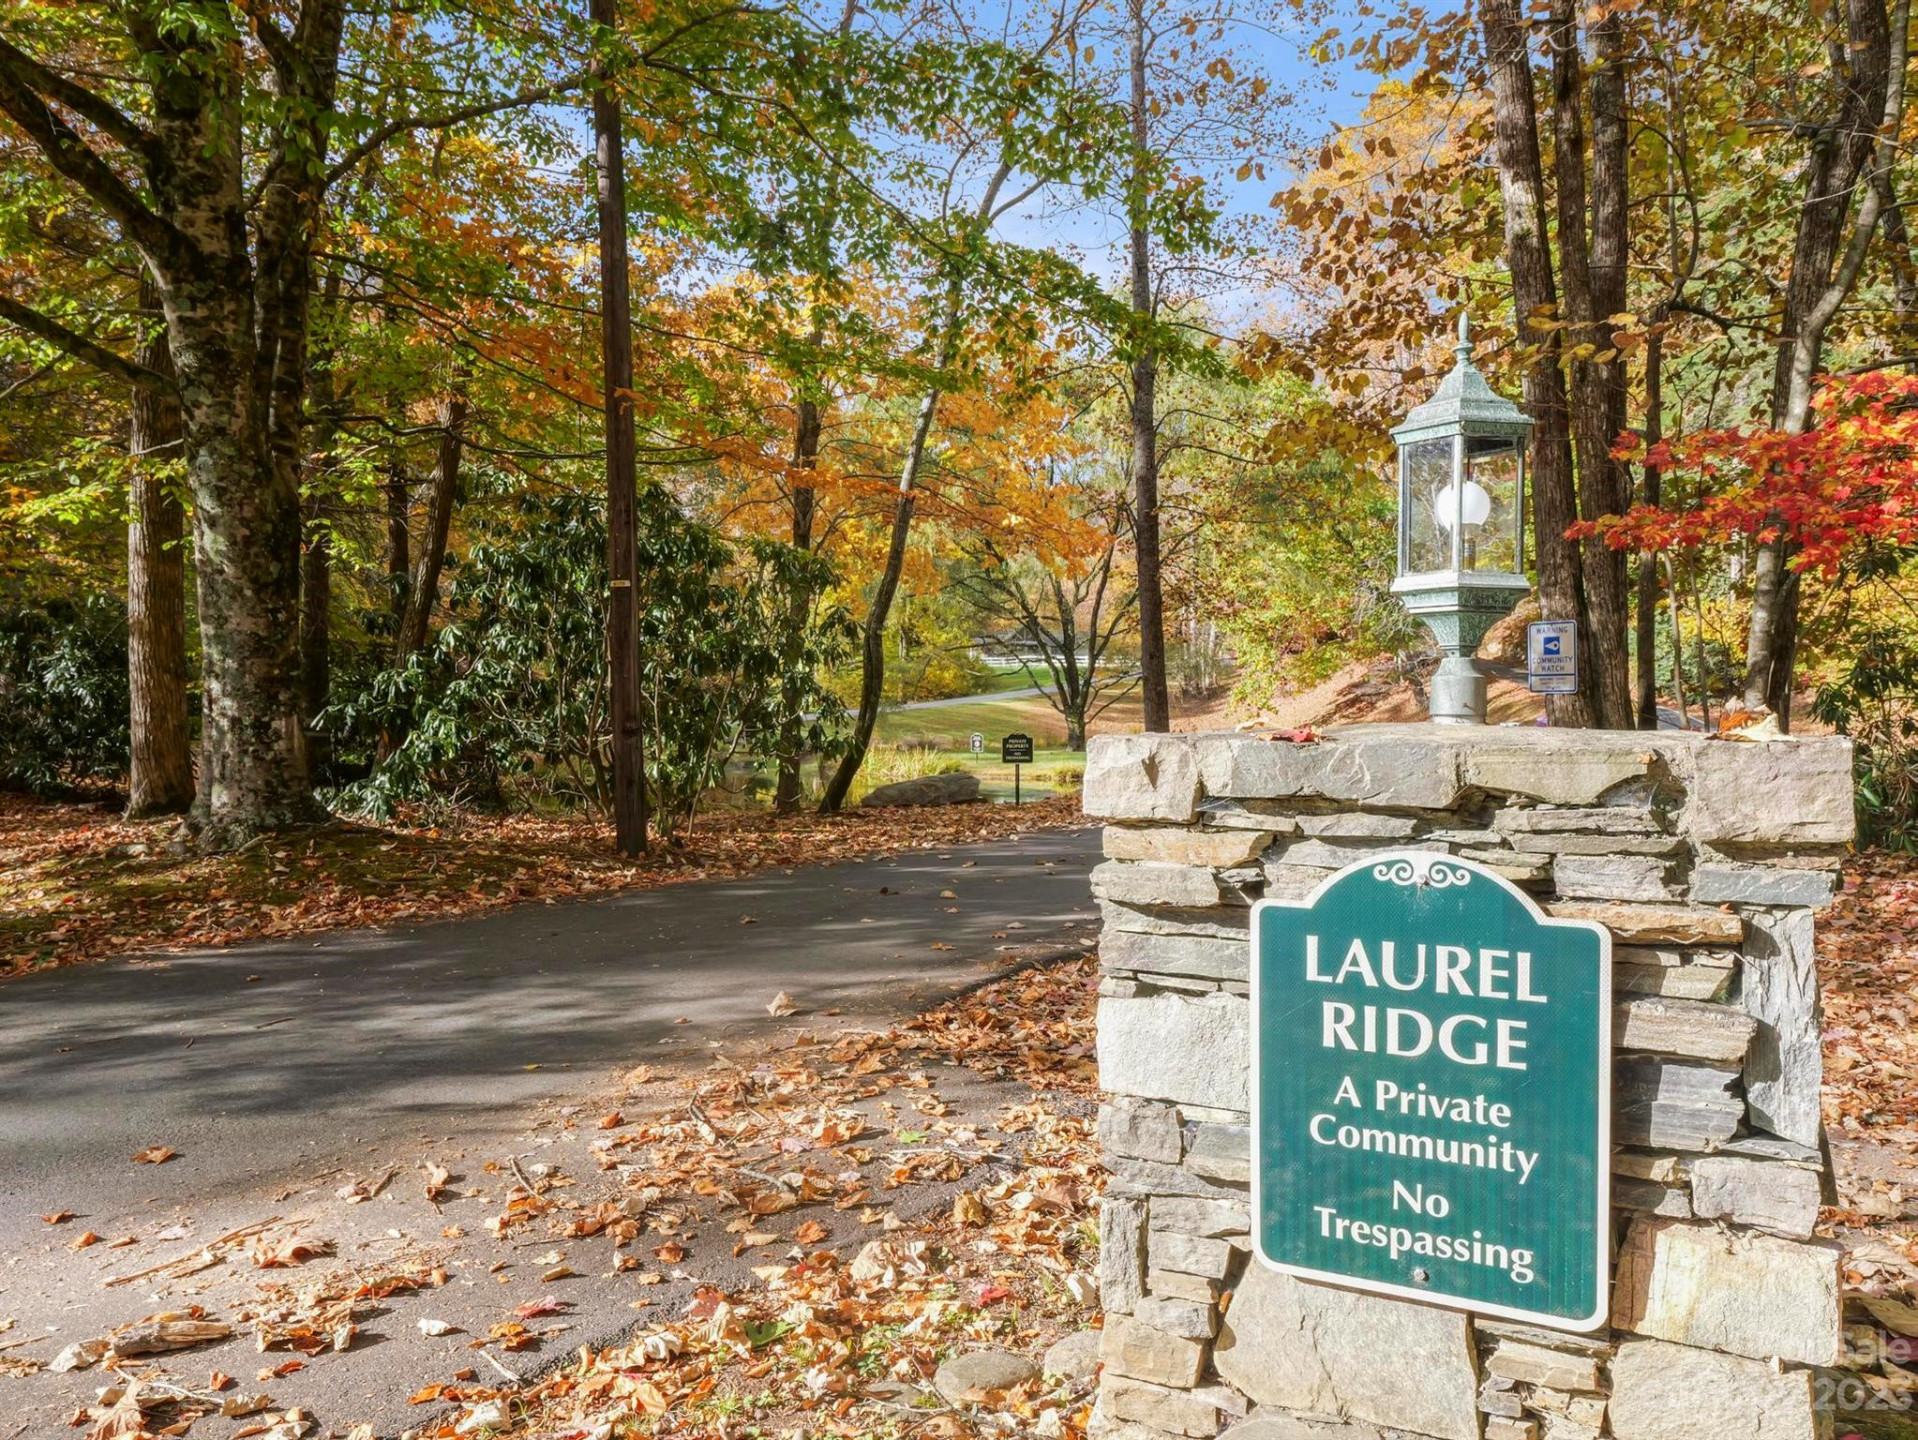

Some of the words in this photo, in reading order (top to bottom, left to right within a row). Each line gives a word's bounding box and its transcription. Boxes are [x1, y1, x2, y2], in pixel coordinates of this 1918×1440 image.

[1533, 656, 1573, 664] COMMUNITY
[1305, 935, 1547, 1003] LAUREL
[1321, 1001, 1528, 1070] RIDGE
[1333, 1075, 1360, 1108] A
[1375, 1079, 1511, 1128] Private
[1309, 1113, 1539, 1184] Community
[1392, 1179, 1449, 1218] No
[1313, 1205, 1534, 1283] Trespassing
